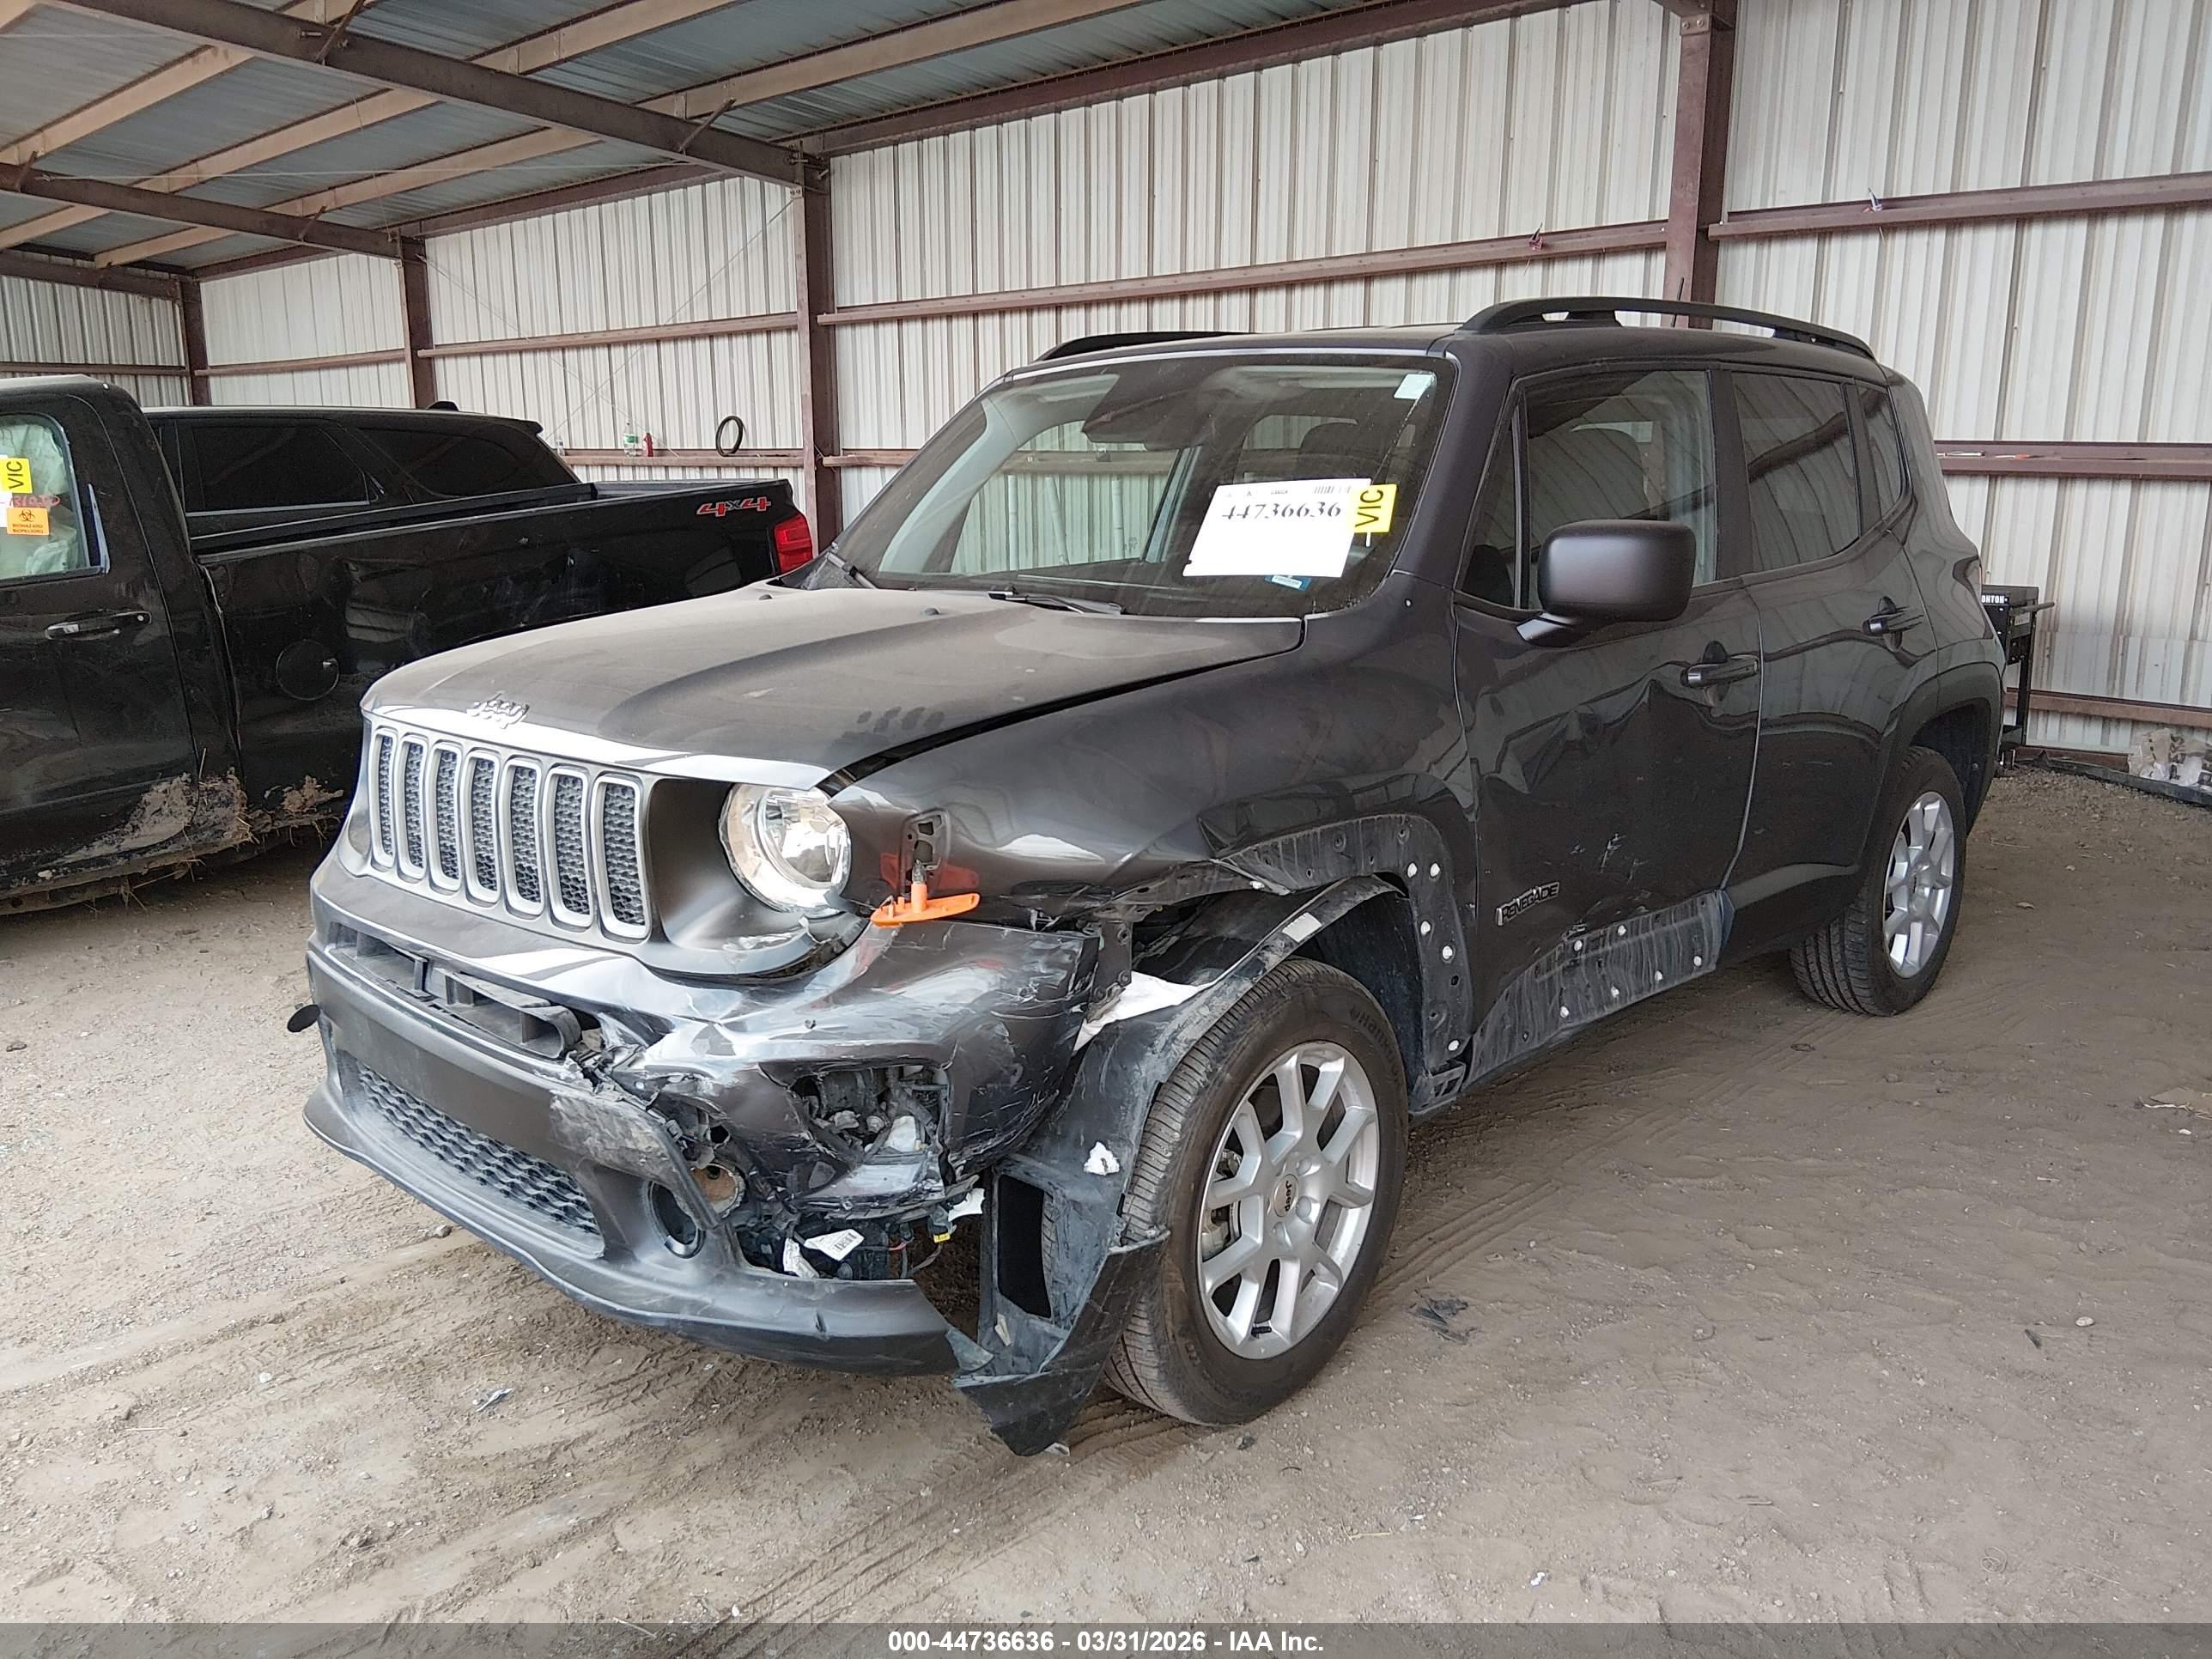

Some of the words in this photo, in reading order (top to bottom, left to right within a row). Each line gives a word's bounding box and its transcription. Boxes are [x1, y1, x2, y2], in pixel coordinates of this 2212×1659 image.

[6, 460, 24, 489] VIC
[1355, 489, 1384, 527] VIC
[1496, 882, 1560, 926] RENEGADE
